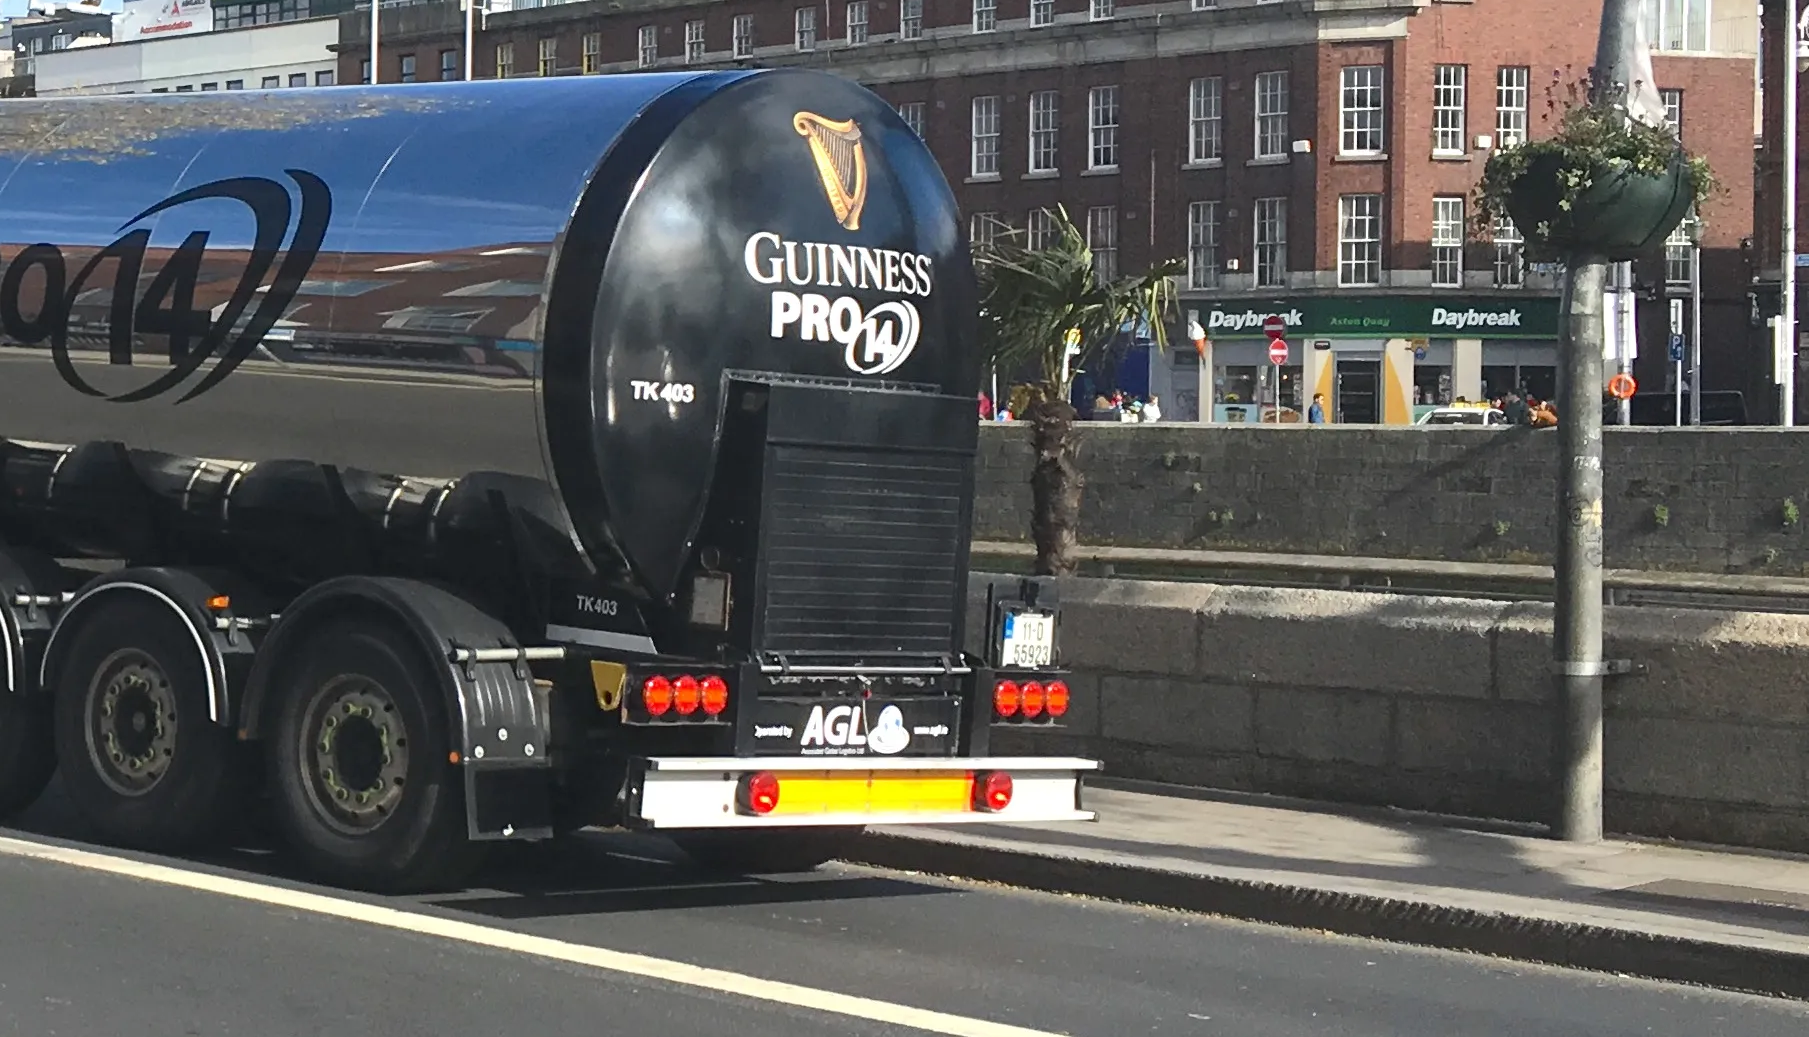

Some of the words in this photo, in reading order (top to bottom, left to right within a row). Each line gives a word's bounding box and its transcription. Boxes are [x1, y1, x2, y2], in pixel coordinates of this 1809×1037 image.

[745, 232, 932, 297] GUINNESS
[1330, 317, 1361, 326] Aston
[1362, 317, 1390, 327] Quay
[1432, 308, 1522, 329] Daybreak
[1013, 644, 1049, 664] 55923
[800, 705, 867, 745] AGL
